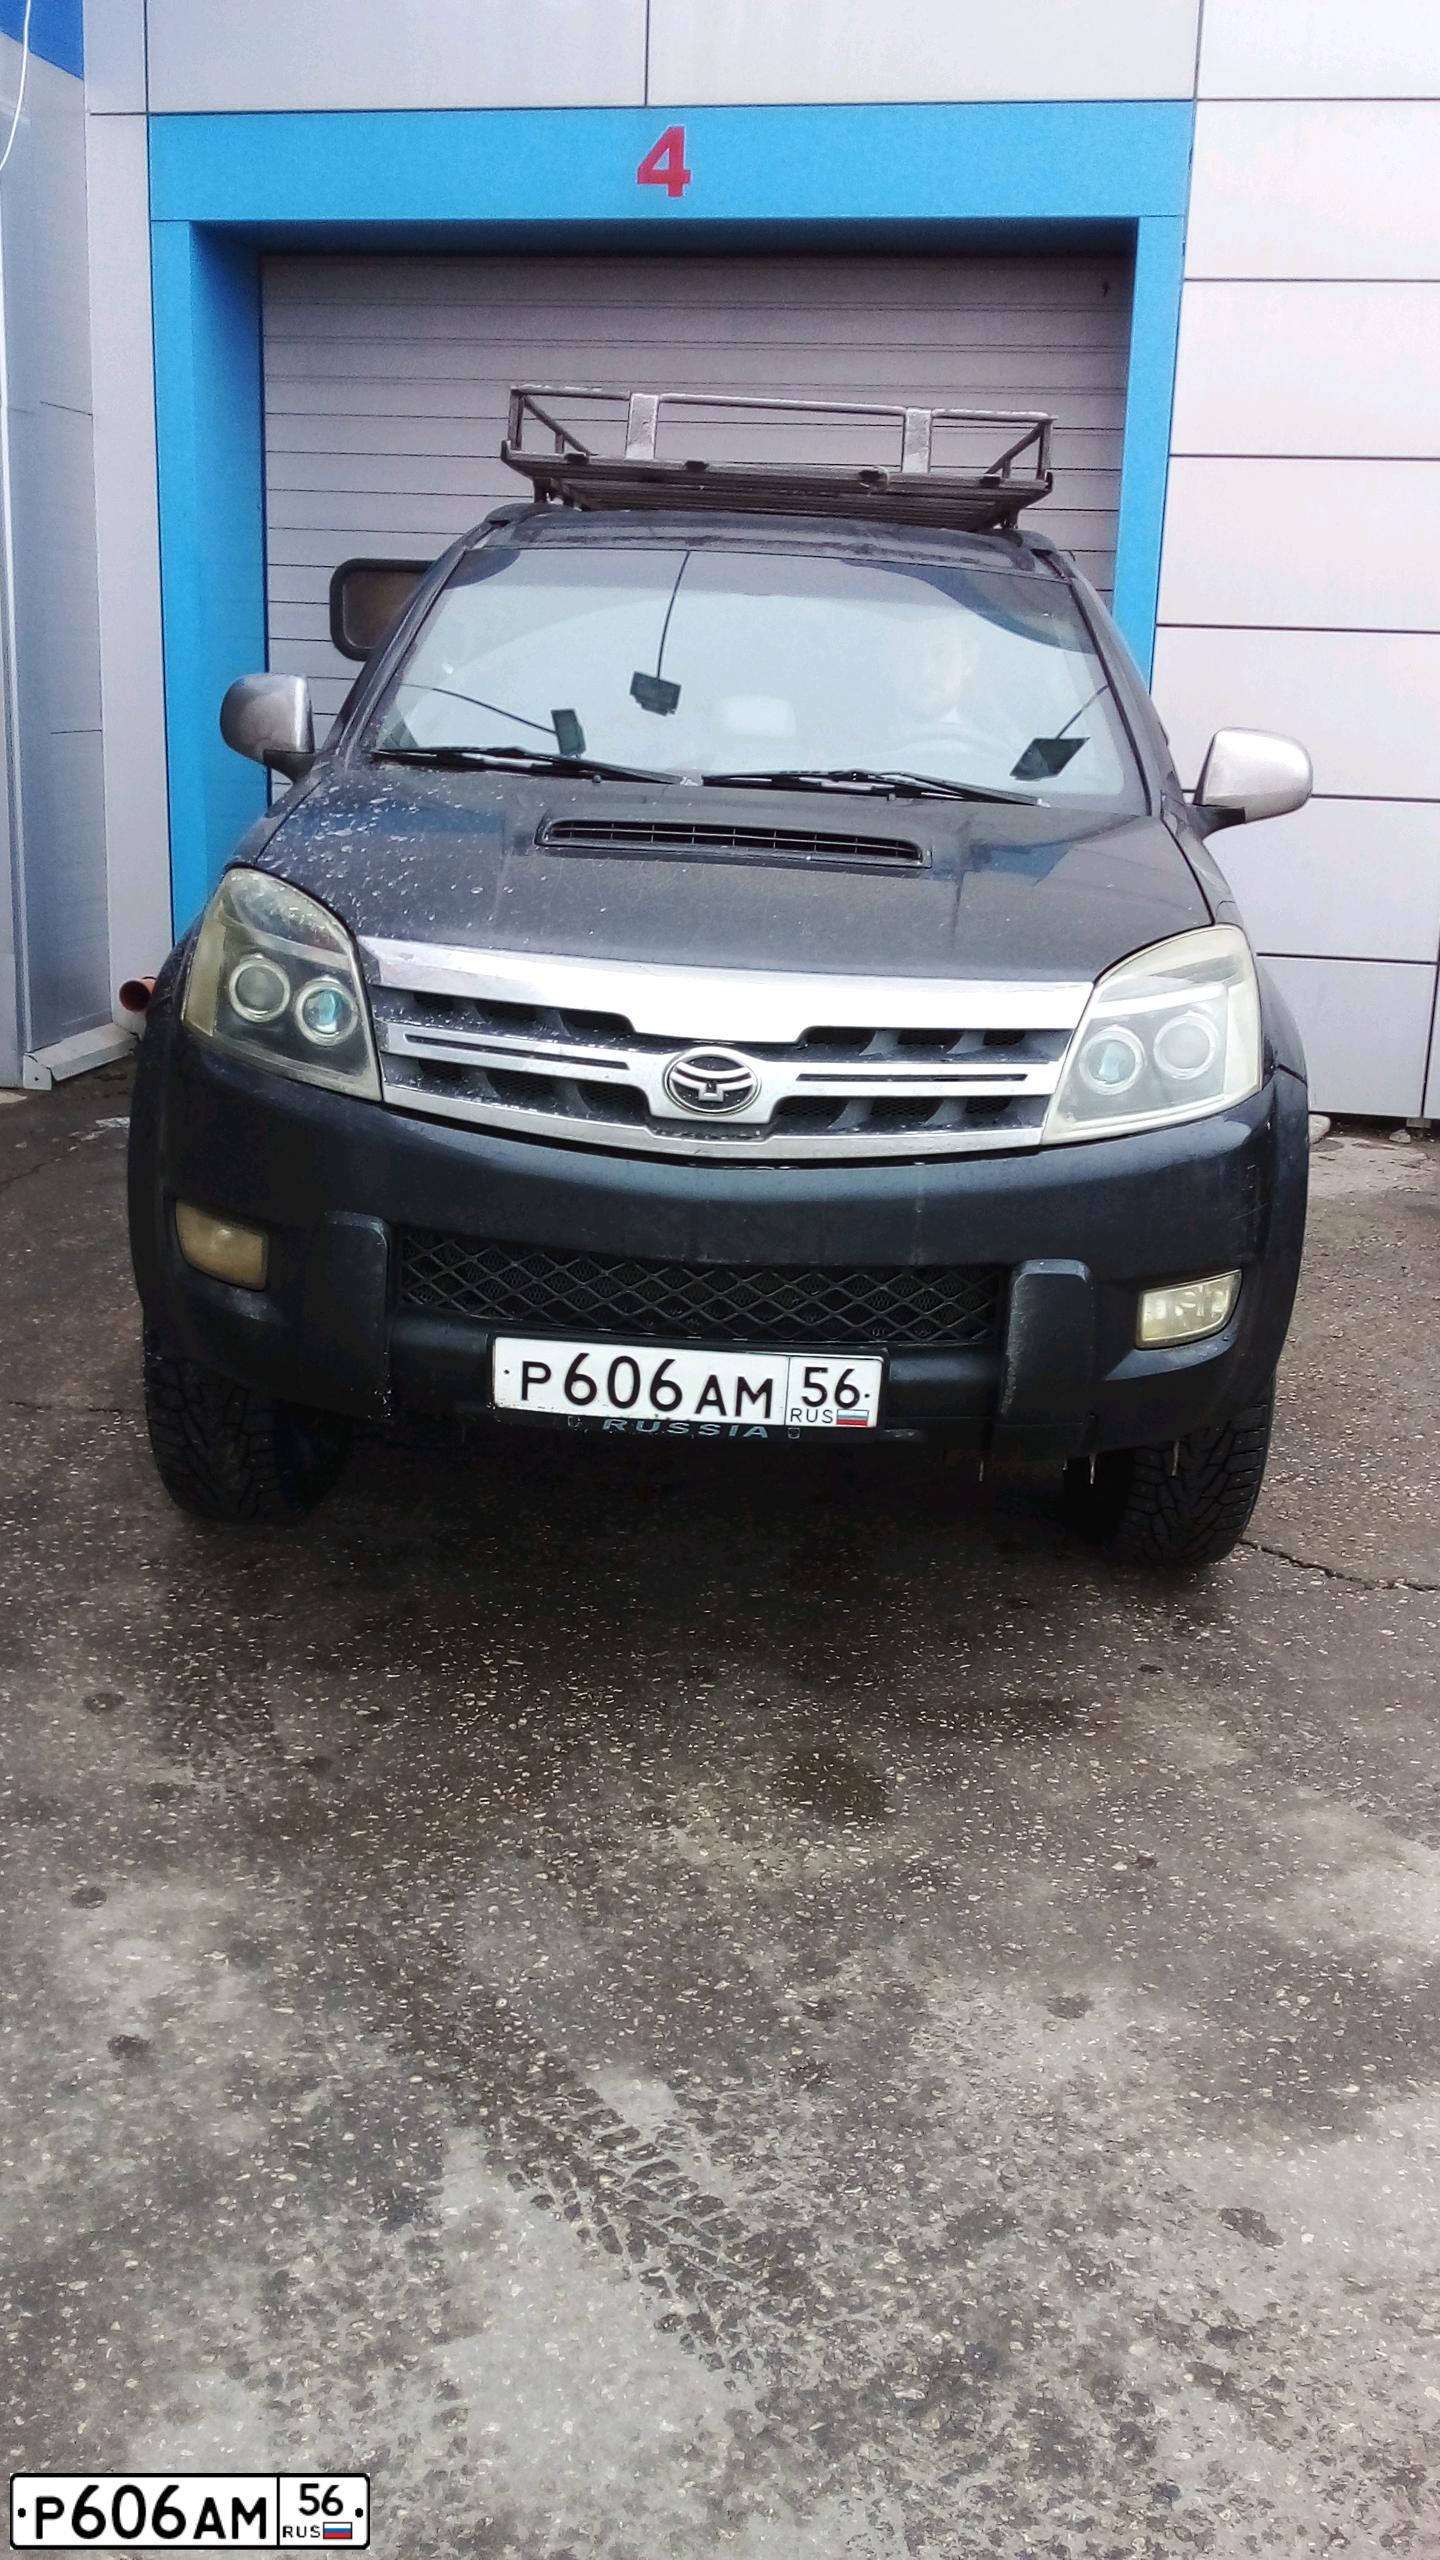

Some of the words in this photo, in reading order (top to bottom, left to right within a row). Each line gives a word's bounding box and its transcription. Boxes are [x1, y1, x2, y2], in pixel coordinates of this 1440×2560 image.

[636, 126, 691, 197] 4
[520, 1352, 774, 1419] P606AM
[800, 1366, 860, 1408] 56
[602, 1418, 769, 1439] RUSSIA
[789, 1408, 834, 1424] RUS
